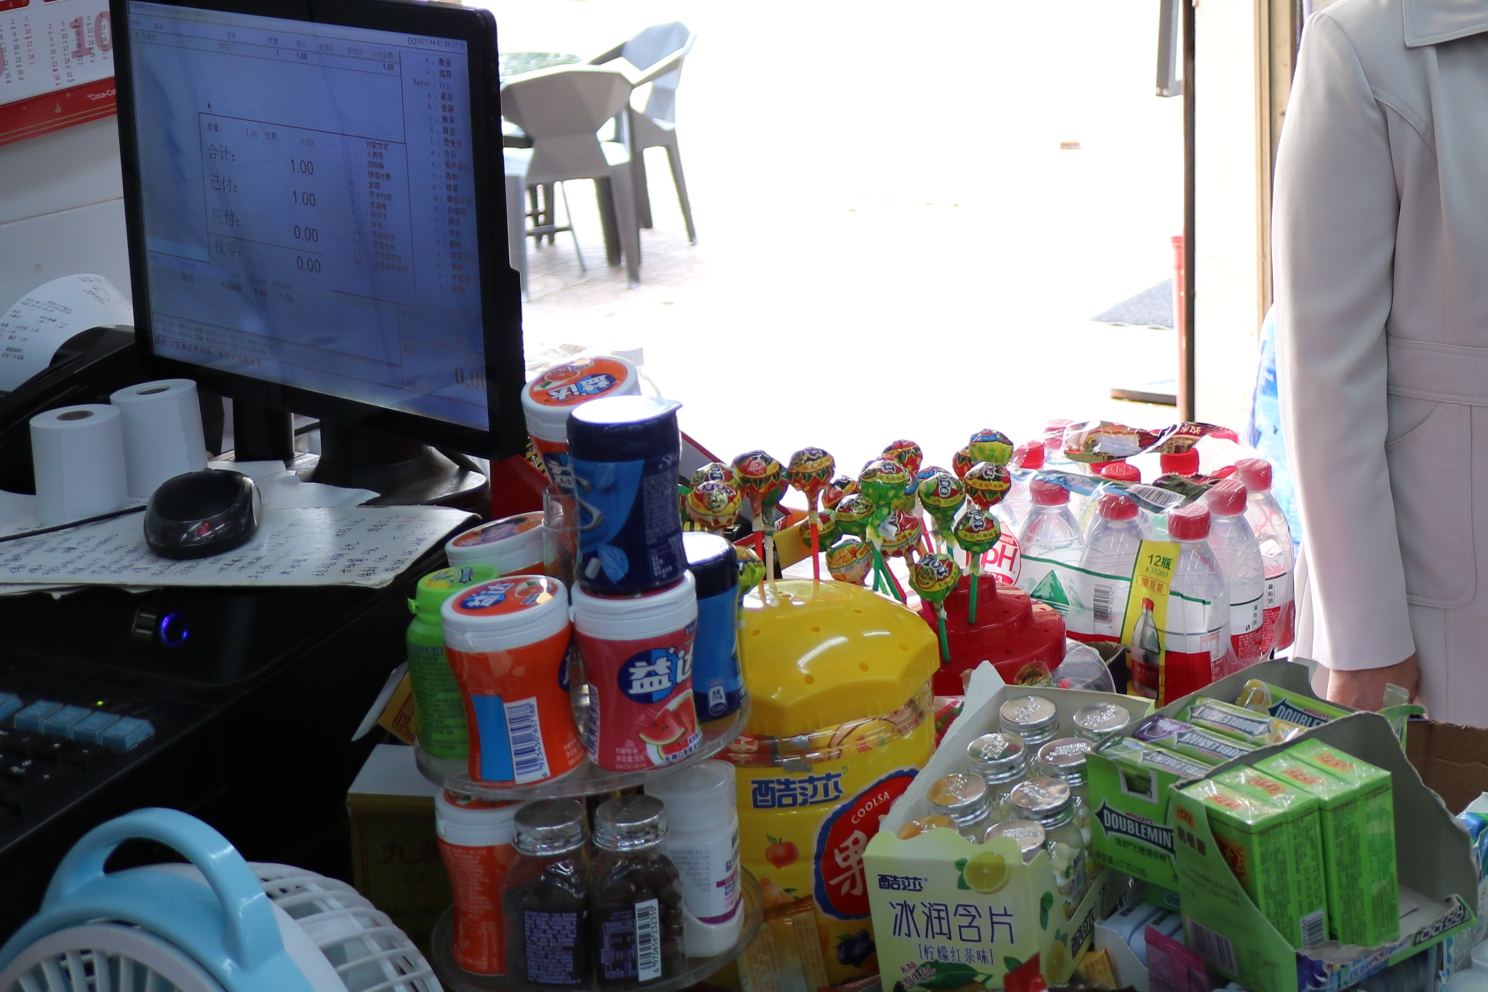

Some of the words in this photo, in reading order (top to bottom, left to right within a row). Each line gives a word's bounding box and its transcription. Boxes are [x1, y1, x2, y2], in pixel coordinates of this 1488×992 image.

[296, 51, 308, 60] 1.00
[382, 62, 394, 71] 1.00
[290, 158, 315, 176] 1.00
[292, 190, 317, 208] 1.00
[294, 225, 319, 243] 0.00
[296, 255, 322, 274] 0.00
[1147, 553, 1173, 571] 12瓶
[750, 772, 843, 809] 酷莎
[851, 791, 890, 825] COOLSA
[1102, 807, 1176, 850] DOUBLEMIN
[878, 873, 924, 893] 酷莎
[888, 899, 1015, 945] 冰润含片
